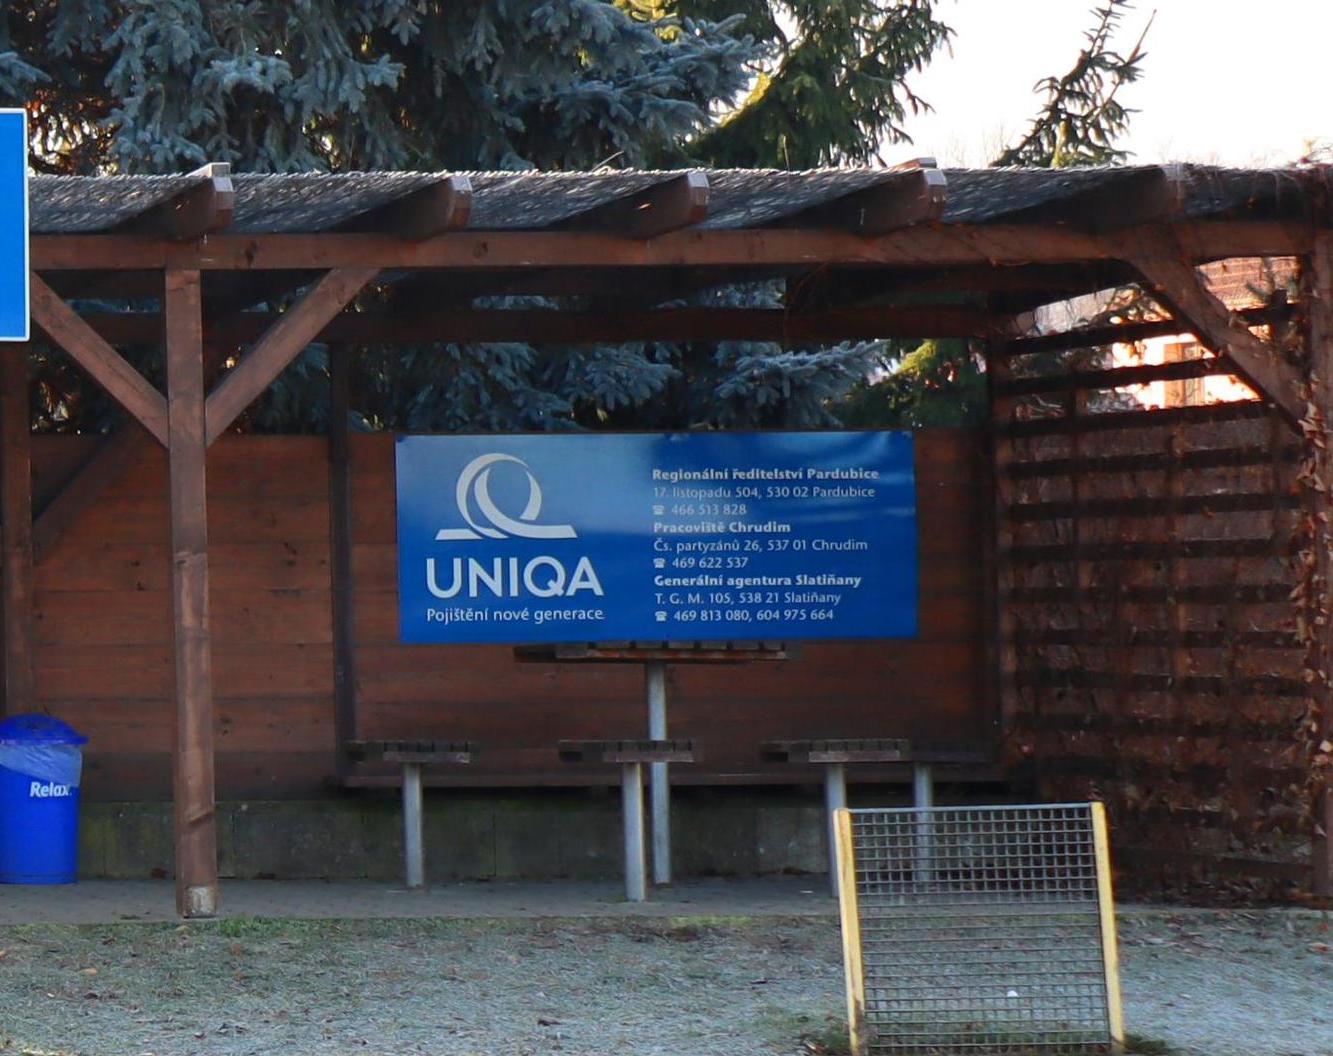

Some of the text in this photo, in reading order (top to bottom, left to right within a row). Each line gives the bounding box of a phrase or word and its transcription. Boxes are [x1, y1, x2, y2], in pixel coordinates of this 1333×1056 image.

[652, 467, 880, 483] Regionální ředitelství Pardubice
[654, 485, 875, 500] 17. listopadu 504, 530 02 Pardubice
[671, 503, 747, 515] 466 513 828
[653, 521, 791, 533] Pracoviště Chrudim
[653, 538, 868, 554] Čs. partyzánů 26, 537 01 Chrudim
[673, 557, 748, 569] 469 622 537
[426, 555, 604, 599] UNIQA
[654, 574, 723, 587] Generální
[727, 575, 792, 589] agentura
[655, 592, 665, 604] T.
[669, 592, 684, 604] G.
[687, 592, 704, 604] M.
[709, 592, 734, 605] 105,
[739, 592, 762, 603] 538
[765, 592, 779, 603] 21
[427, 607, 605, 625] Pojištění nové generace
[673, 609, 834, 623] 469 813 080, 604 975 664
[29, 781, 70, 798] Relax
